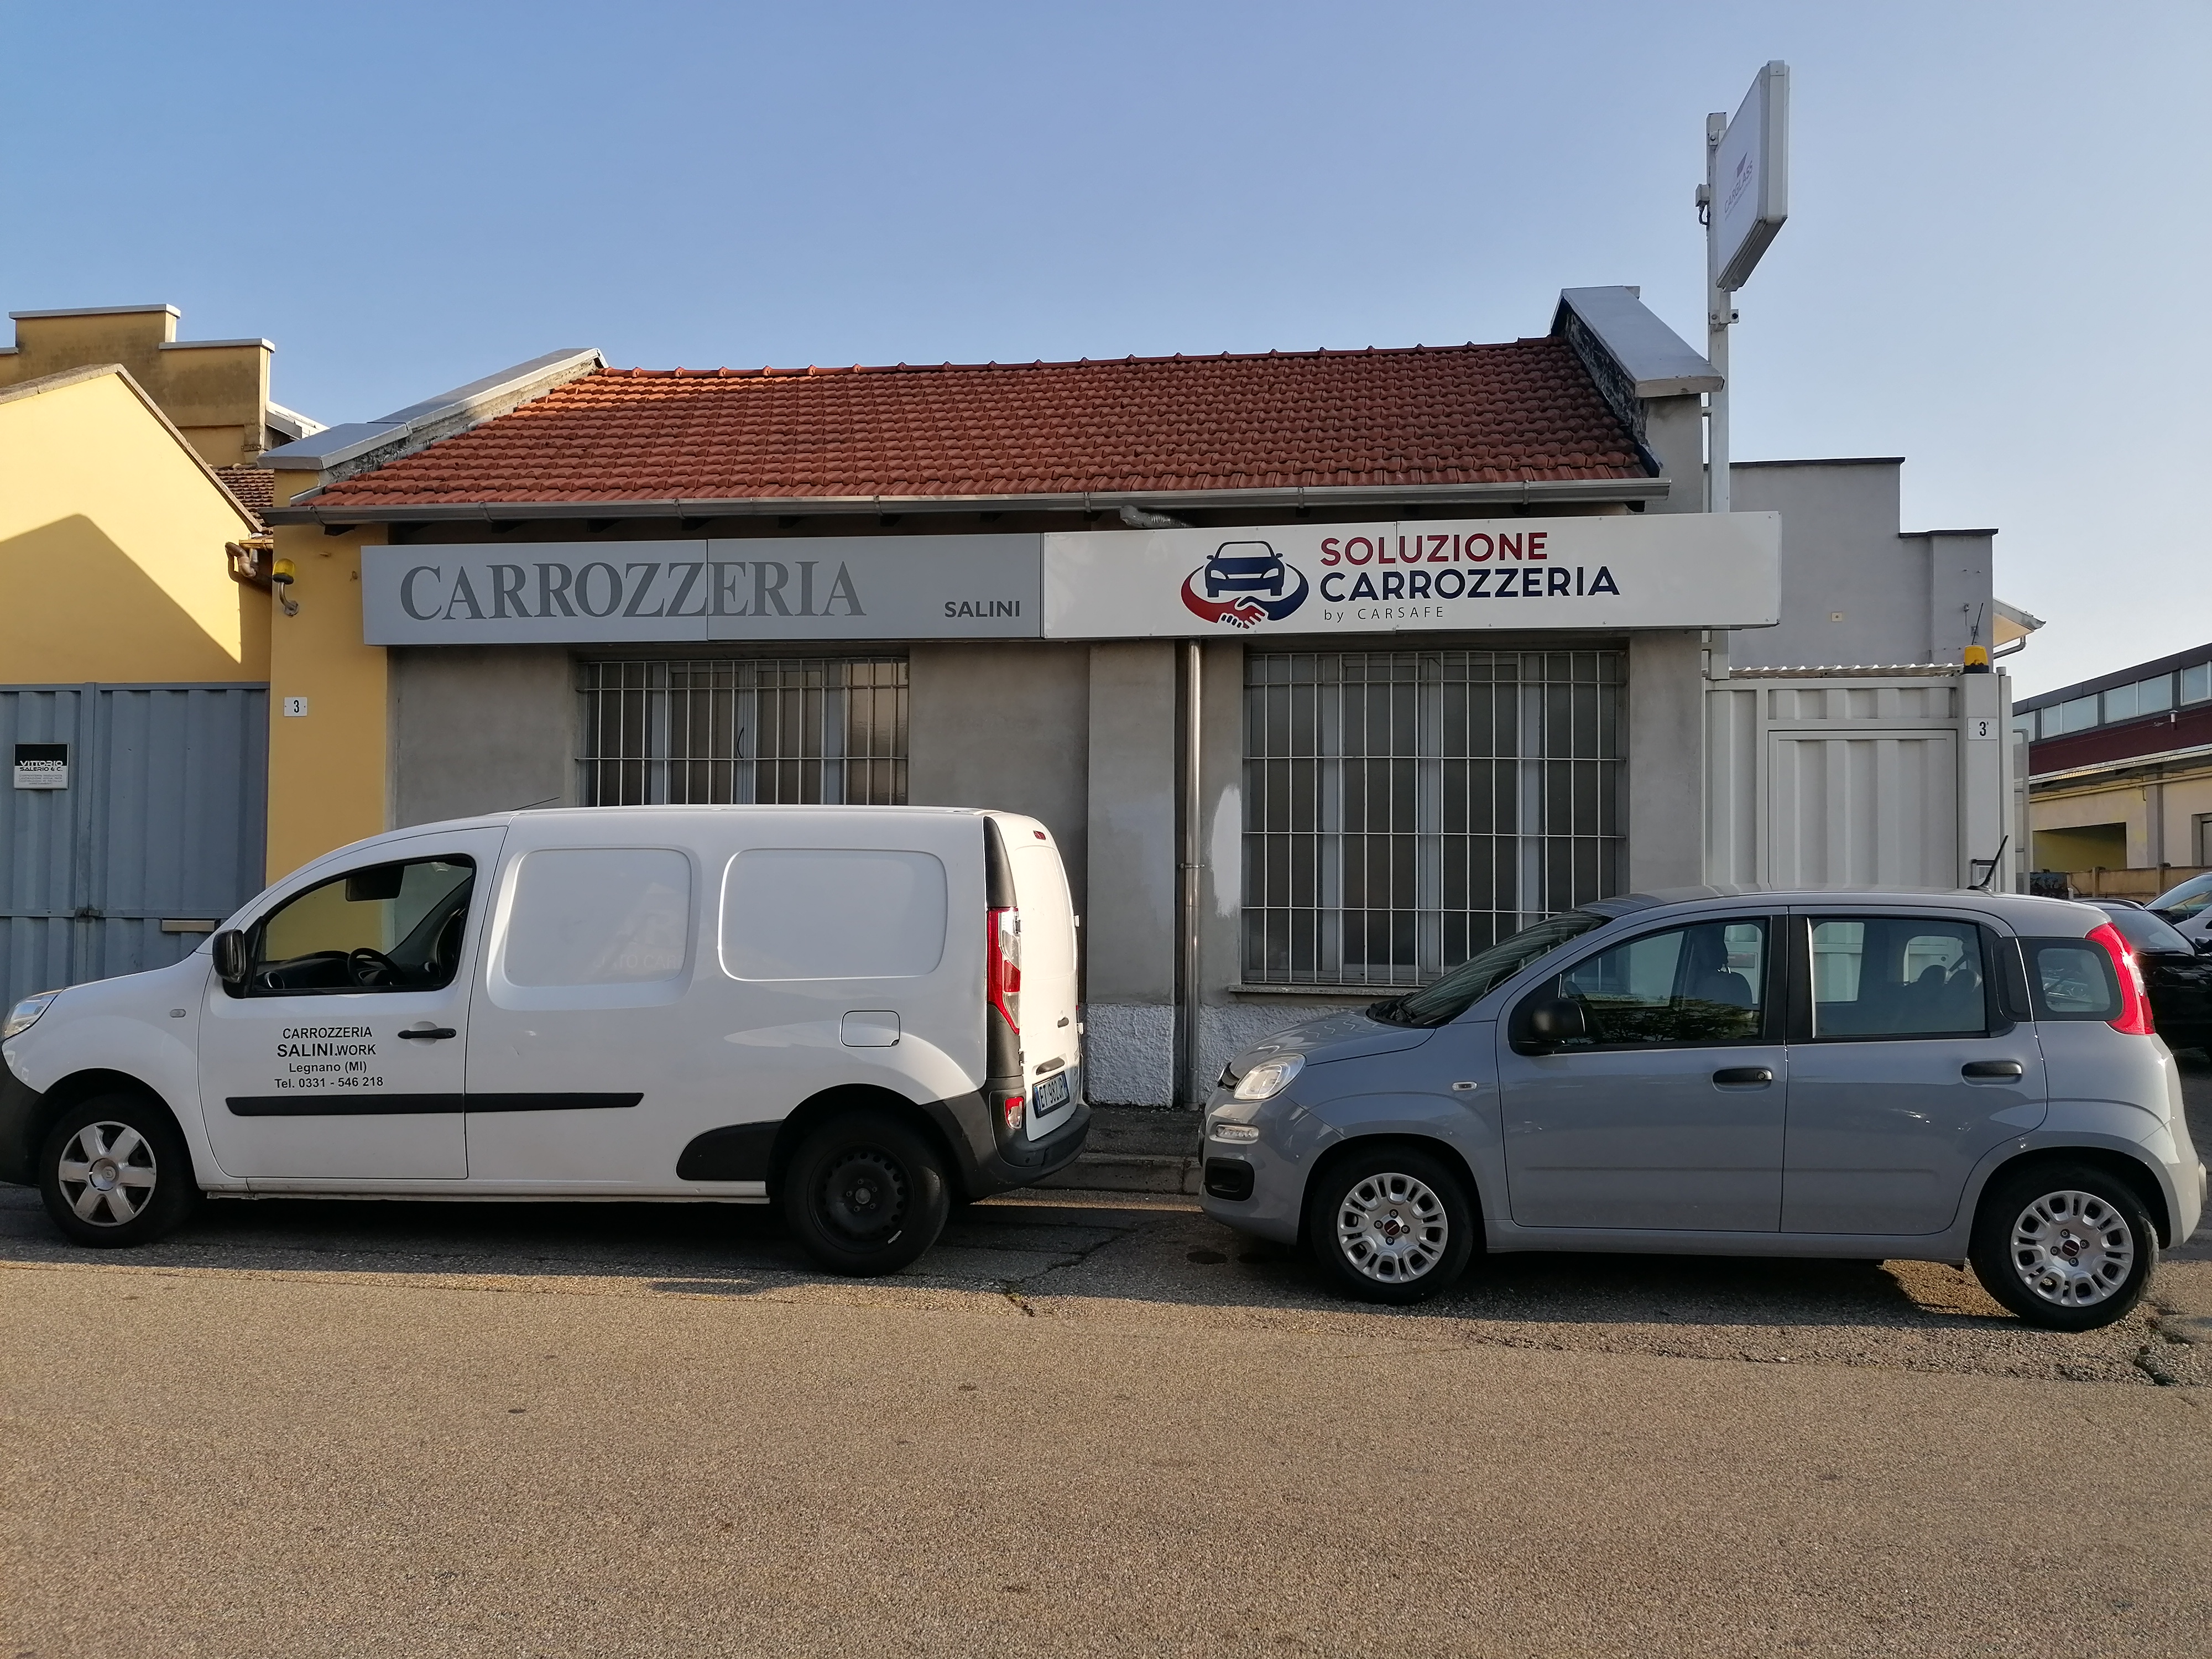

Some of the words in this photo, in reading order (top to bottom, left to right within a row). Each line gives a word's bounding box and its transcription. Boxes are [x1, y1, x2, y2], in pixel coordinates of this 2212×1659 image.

[1724, 159, 1753, 214] CARGLASS
[1320, 532, 1548, 566] SOLUZIONE
[400, 561, 867, 620] CARROZZERIA
[1320, 566, 1620, 602] CARROZZERIA
[944, 601, 1021, 618] SALINI
[1324, 609, 1344, 623] by
[1358, 607, 1443, 620] CARSAFE
[294, 700, 299, 713] 3
[283, 1027, 373, 1039] CARROZZERIA
[289, 1062, 341, 1074] Legnano
[345, 1061, 367, 1073] (MI)
[274, 1078, 295, 1088] Tel.
[299, 1078, 326, 1088] 0331
[338, 1077, 359, 1087] 546
[362, 1077, 384, 1087] 218
[1039, 1085, 1048, 1108] ET
